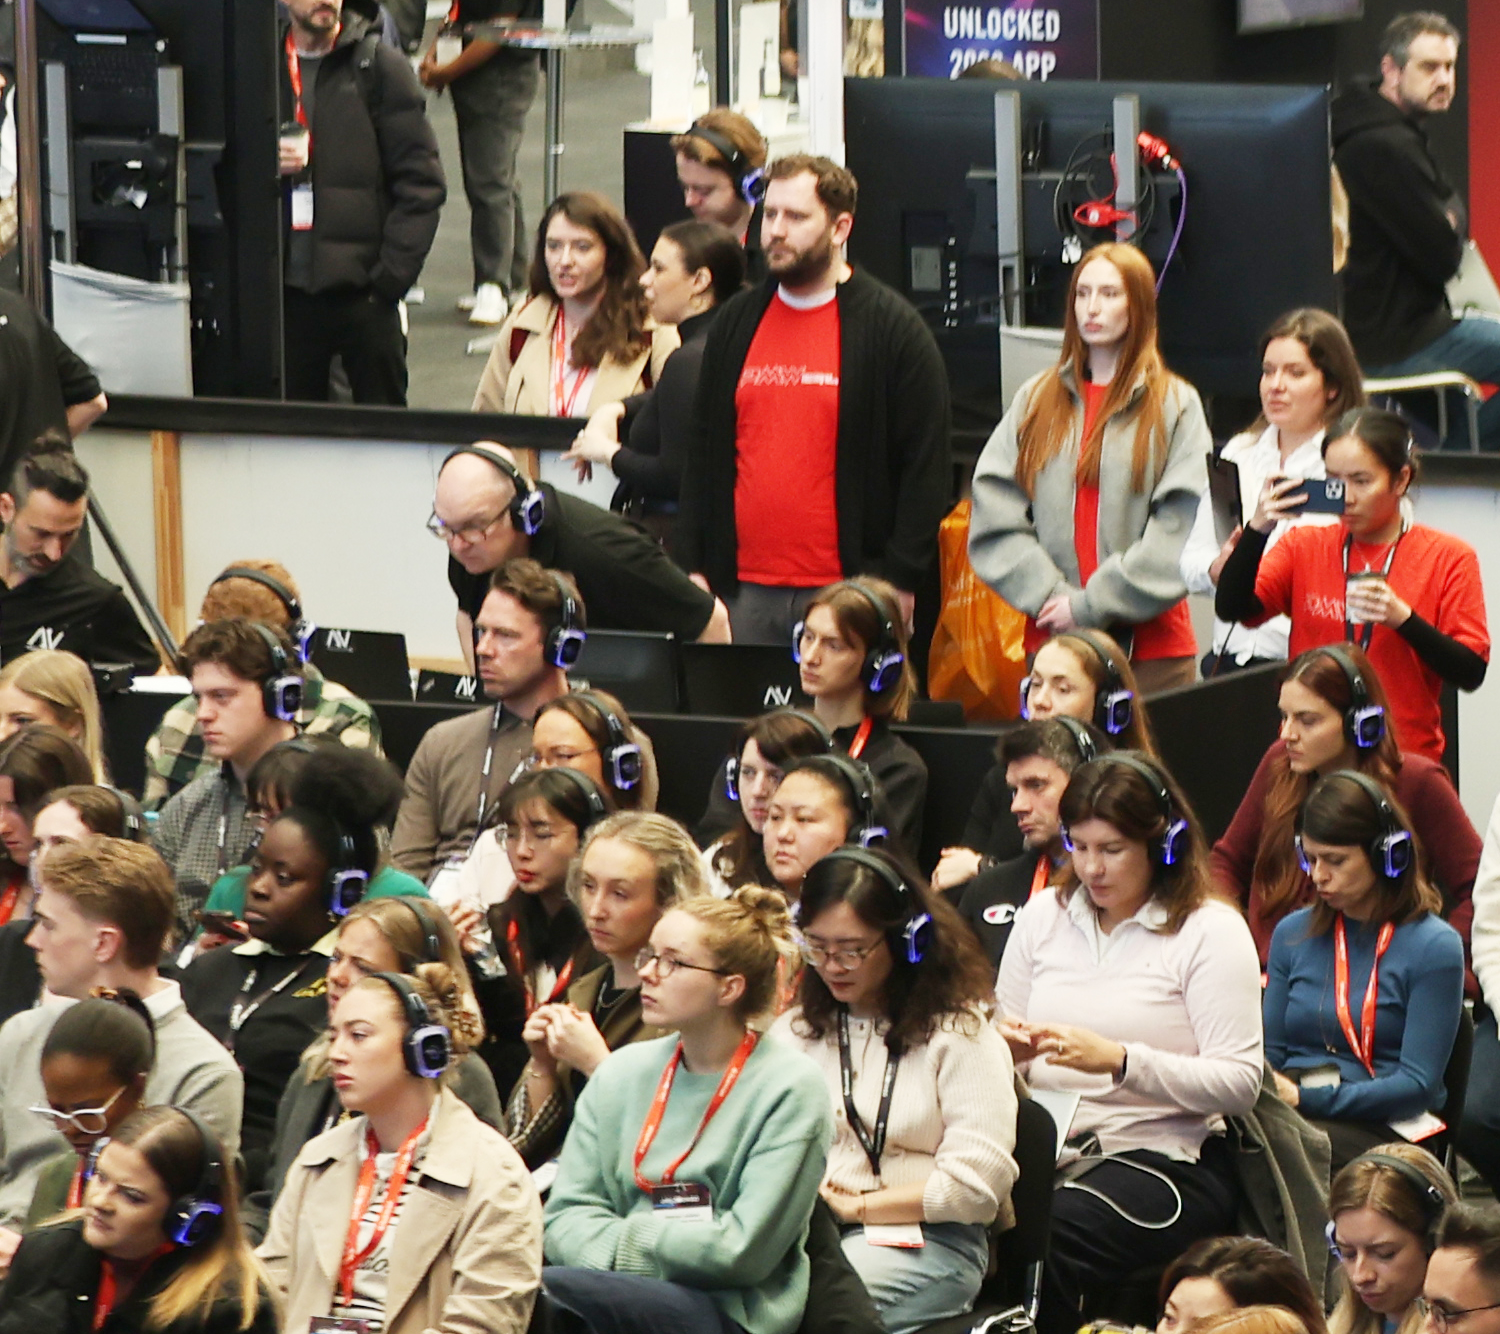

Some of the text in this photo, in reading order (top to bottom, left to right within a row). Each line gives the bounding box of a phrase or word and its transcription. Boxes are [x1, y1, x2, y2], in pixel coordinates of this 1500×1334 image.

[943, 6, 1061, 42] UNLOCKED
[1012, 50, 1057, 83] APP
[763, 685, 792, 706] AV
